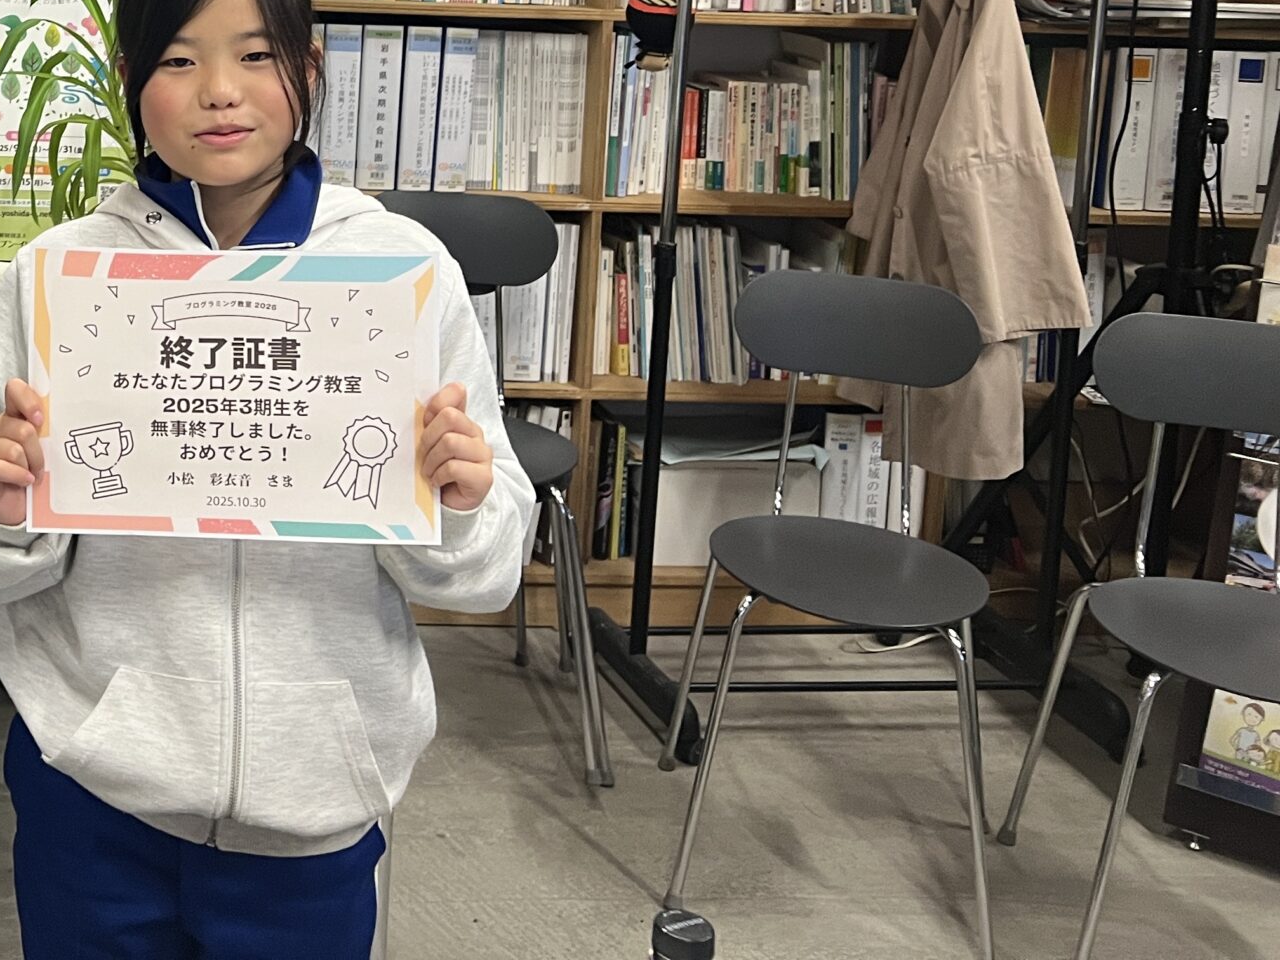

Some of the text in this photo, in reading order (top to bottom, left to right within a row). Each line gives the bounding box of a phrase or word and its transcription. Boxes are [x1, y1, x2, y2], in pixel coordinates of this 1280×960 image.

[373, 43, 390, 163] 岩手県次期総合計画
[185, 300, 252, 310] プログラミング教室
[160, 336, 302, 371] 終了証書
[113, 373, 363, 395] あたなたプログラミング教室
[163, 397, 310, 418] 2025年3期生を
[150, 420, 313, 442] 無事終了しました。
[180, 443, 288, 463] おめでとう！
[167, 472, 195, 485] 小松
[267, 474, 293, 488] さま
[206, 495, 266, 508] 2025.10.30
